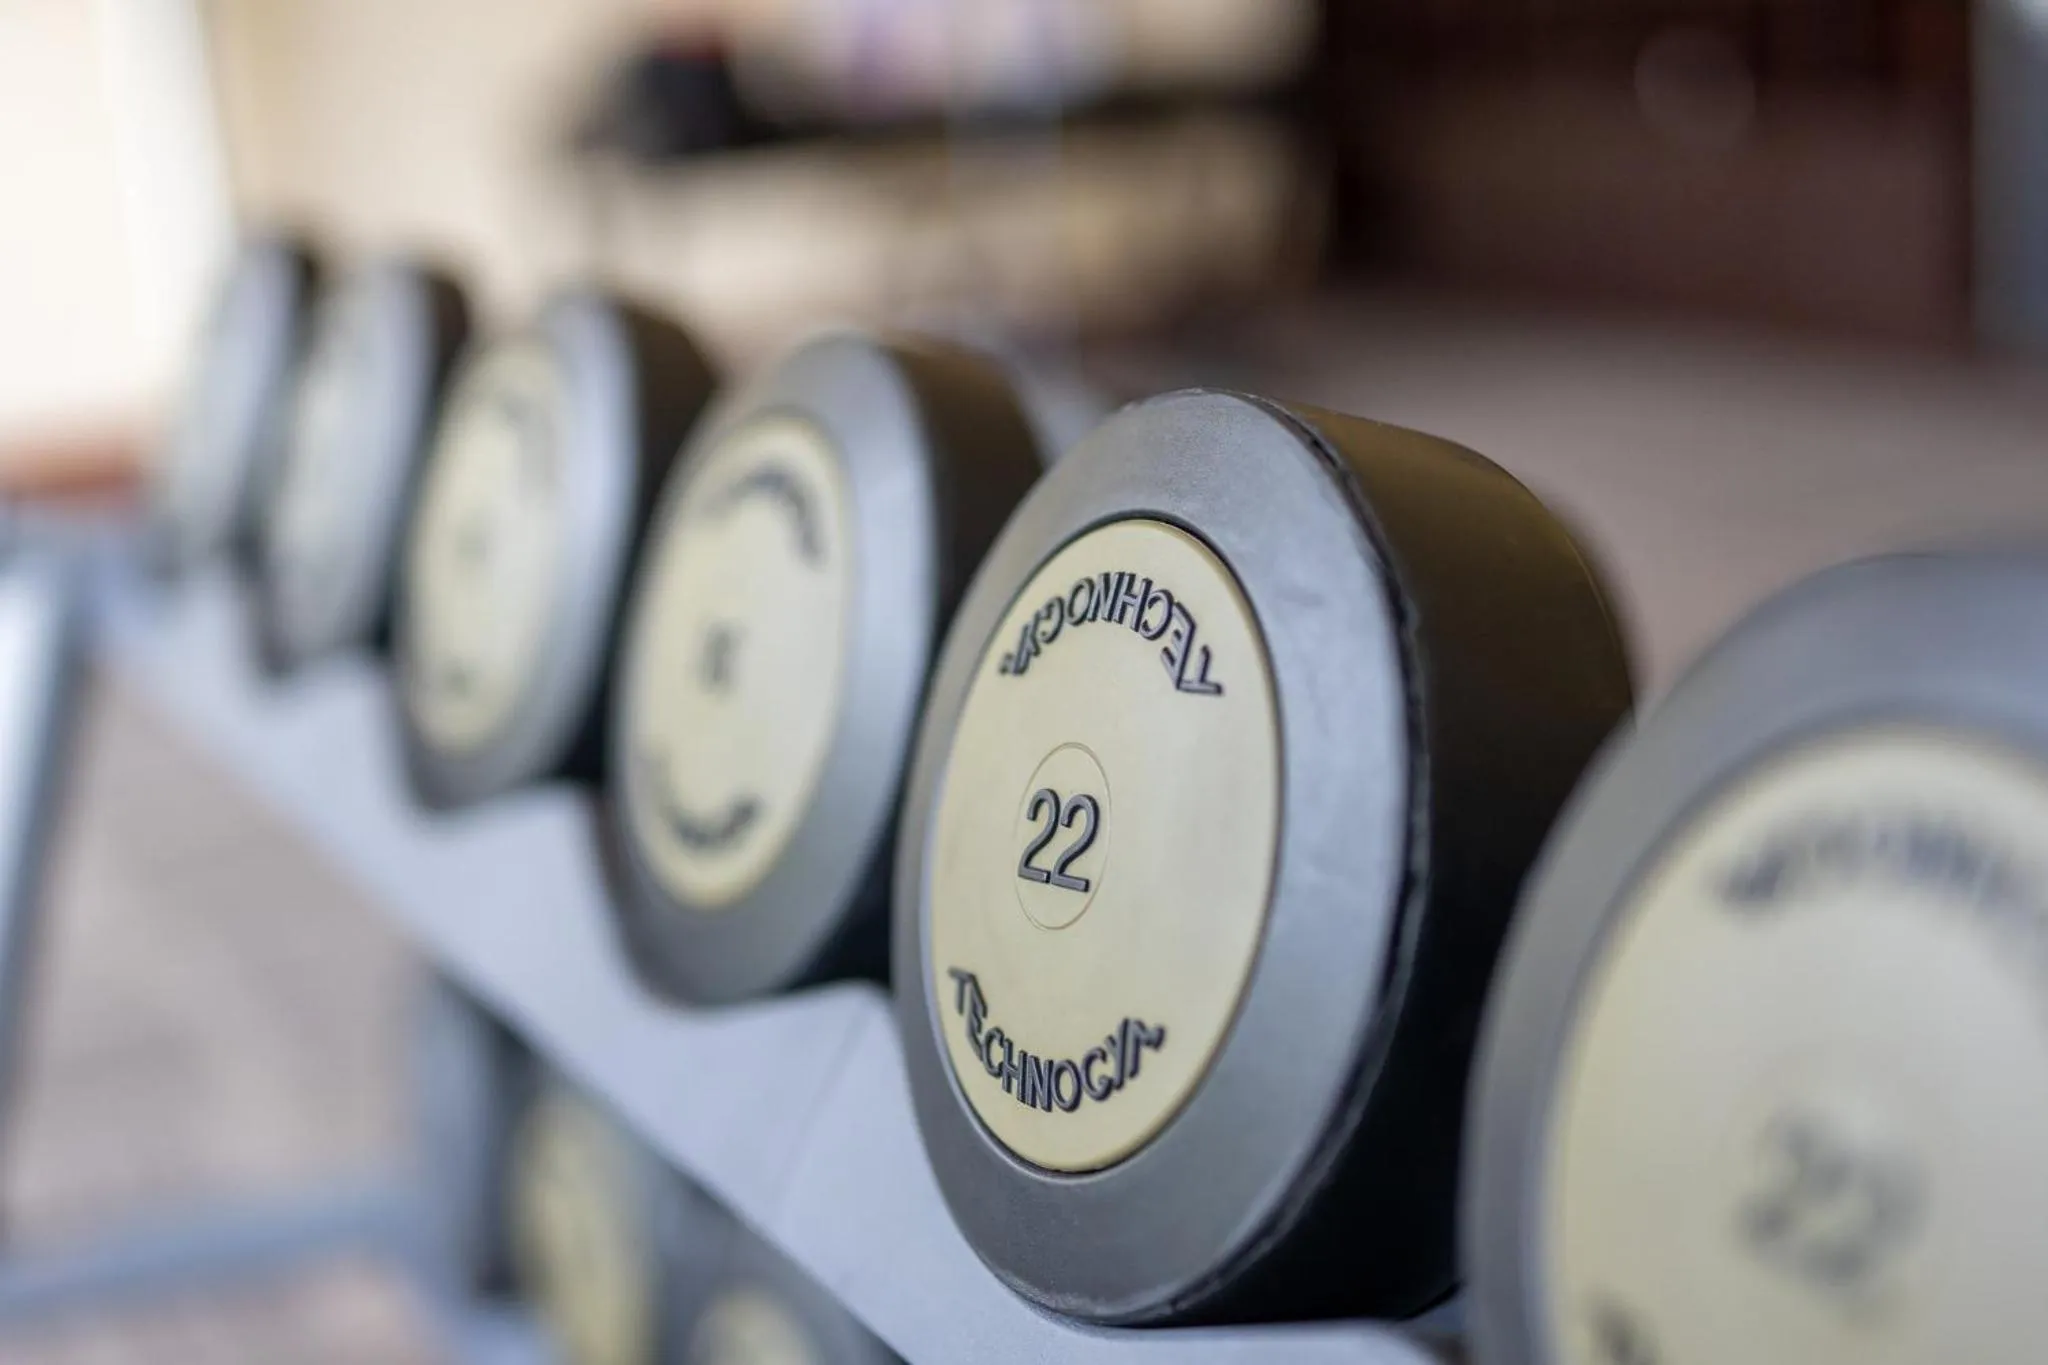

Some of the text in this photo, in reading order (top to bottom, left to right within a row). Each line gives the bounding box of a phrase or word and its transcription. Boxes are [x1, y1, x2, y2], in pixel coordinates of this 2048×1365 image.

[998, 571, 1224, 696] TECHNOGYM
[1017, 788, 1100, 893] 22
[947, 966, 1166, 1112] TECHNOGYM
